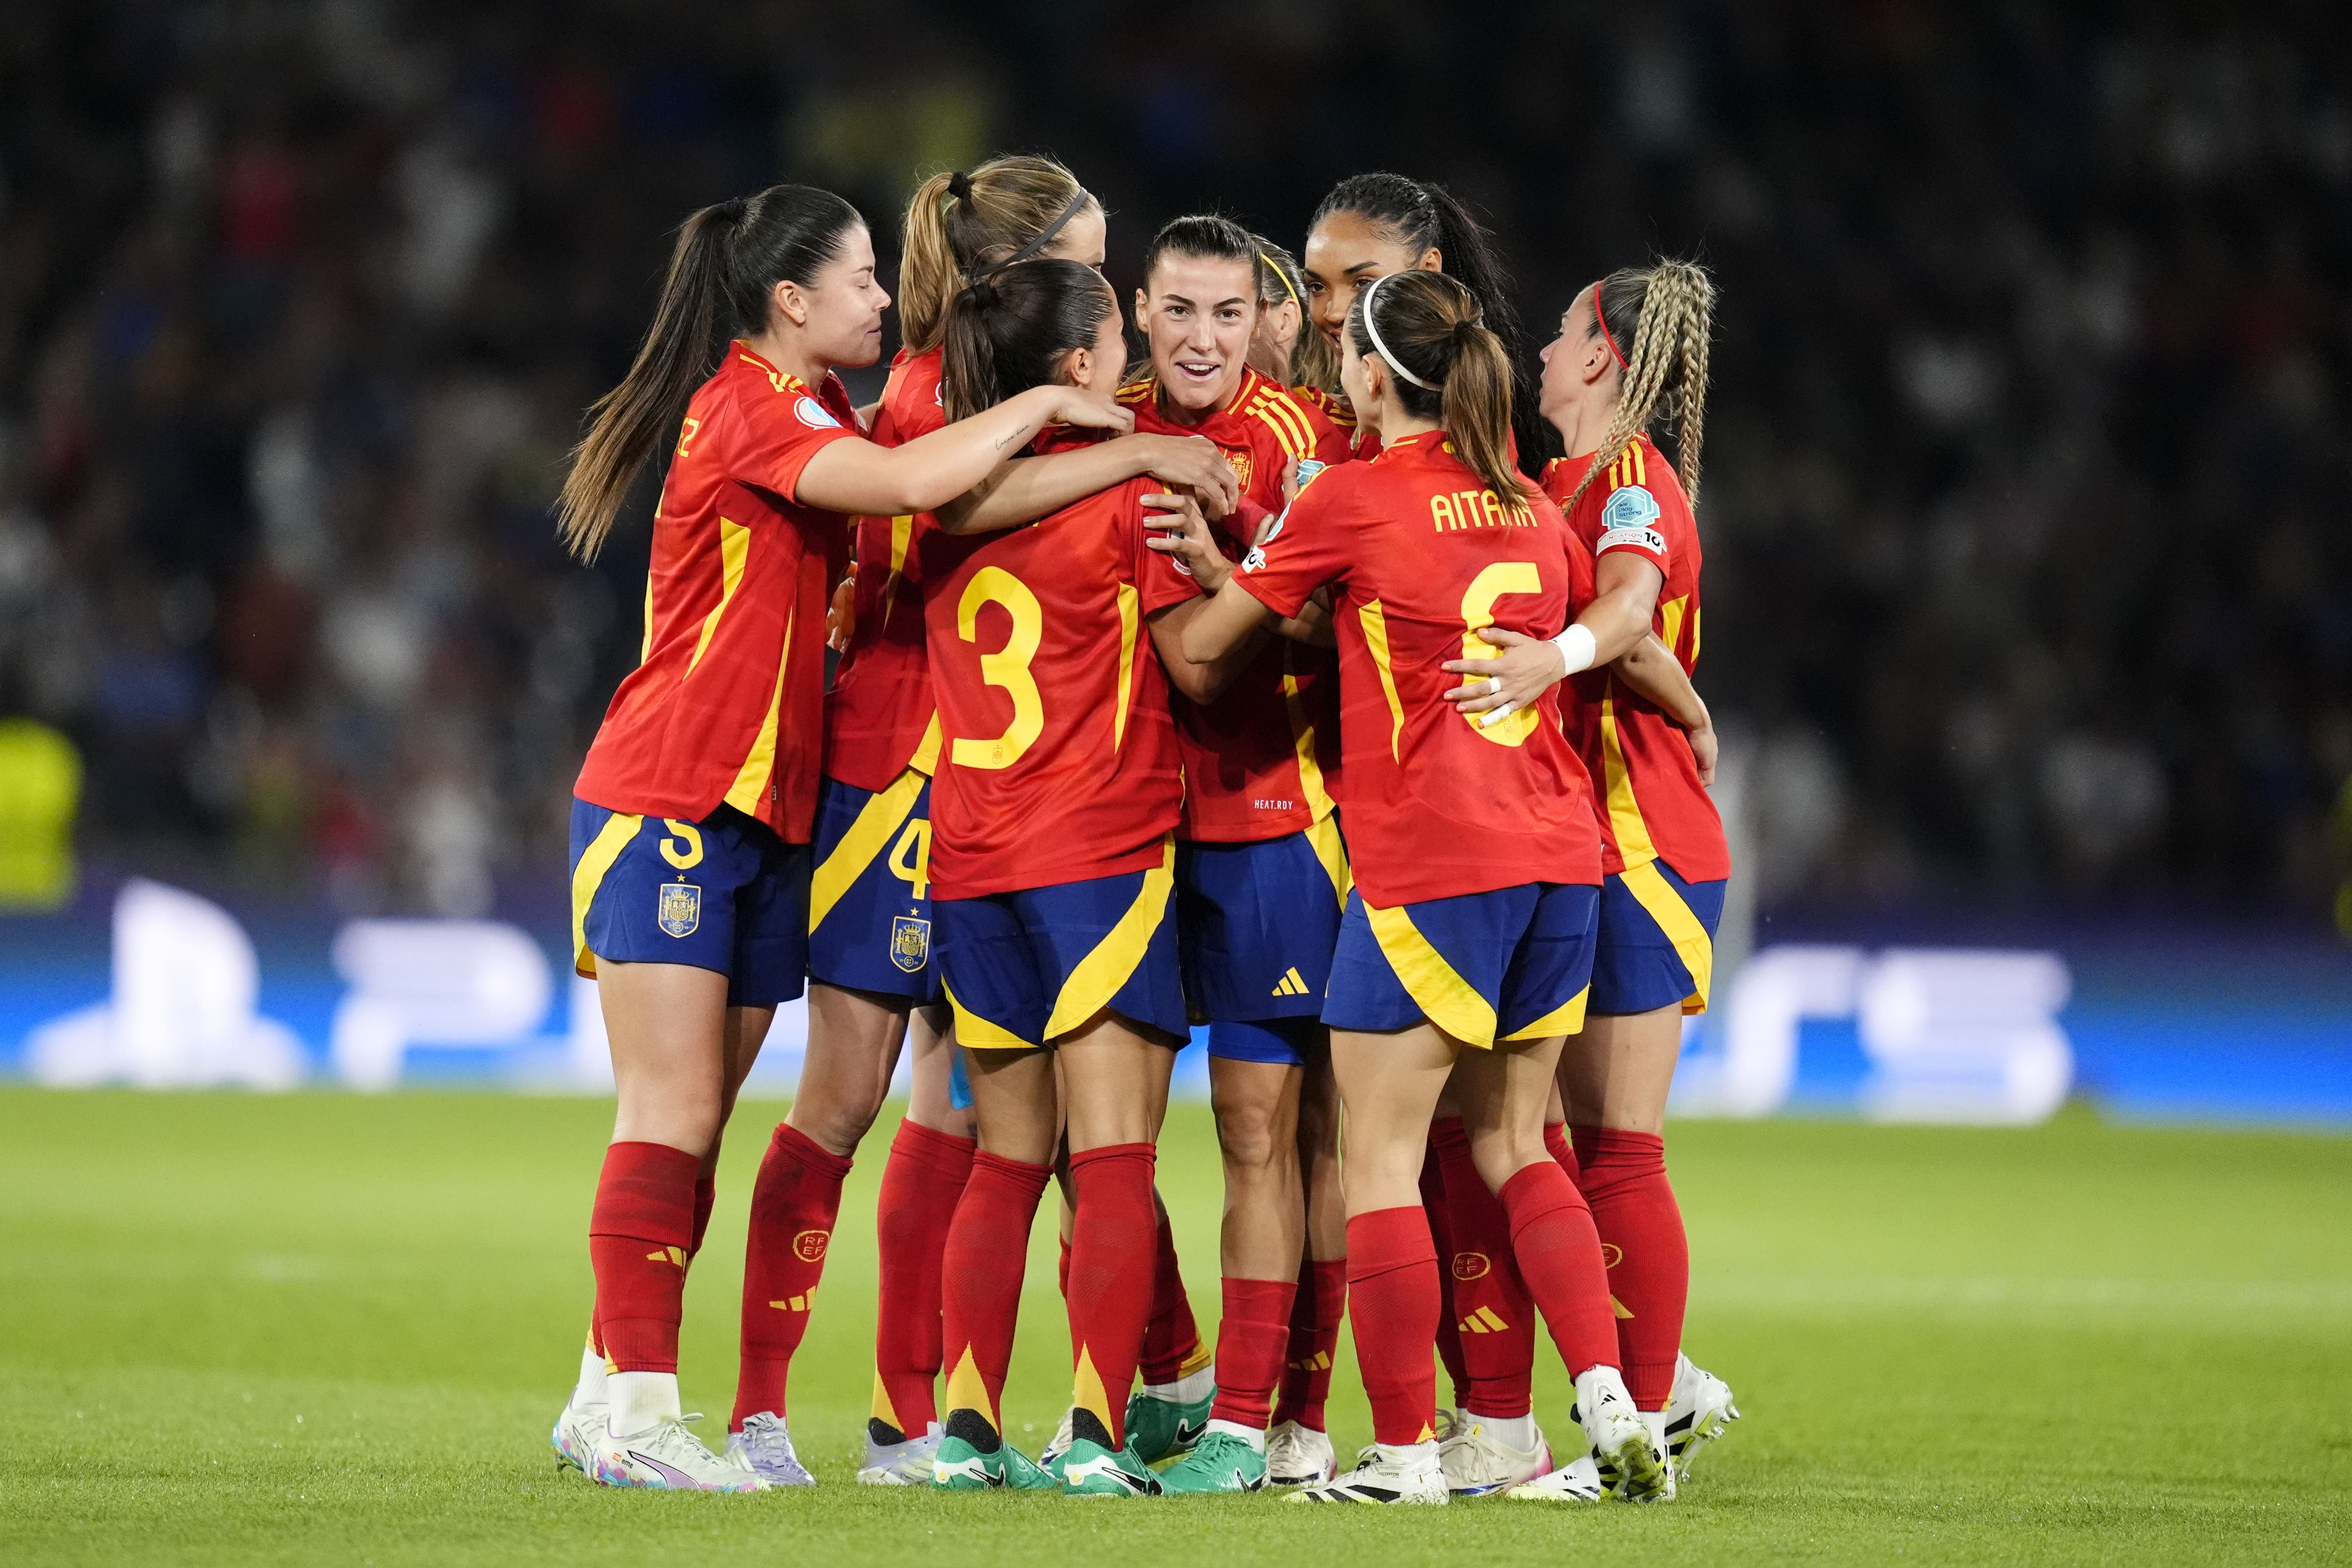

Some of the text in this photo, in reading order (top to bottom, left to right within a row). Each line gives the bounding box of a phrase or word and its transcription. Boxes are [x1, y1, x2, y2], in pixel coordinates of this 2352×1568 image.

[952, 566, 1044, 769] 3
[1461, 563, 1542, 747] 6
[1255, 799, 1292, 810] HEAT.RDY
[888, 818, 932, 900] 4
[803, 1246, 823, 1255] EF
